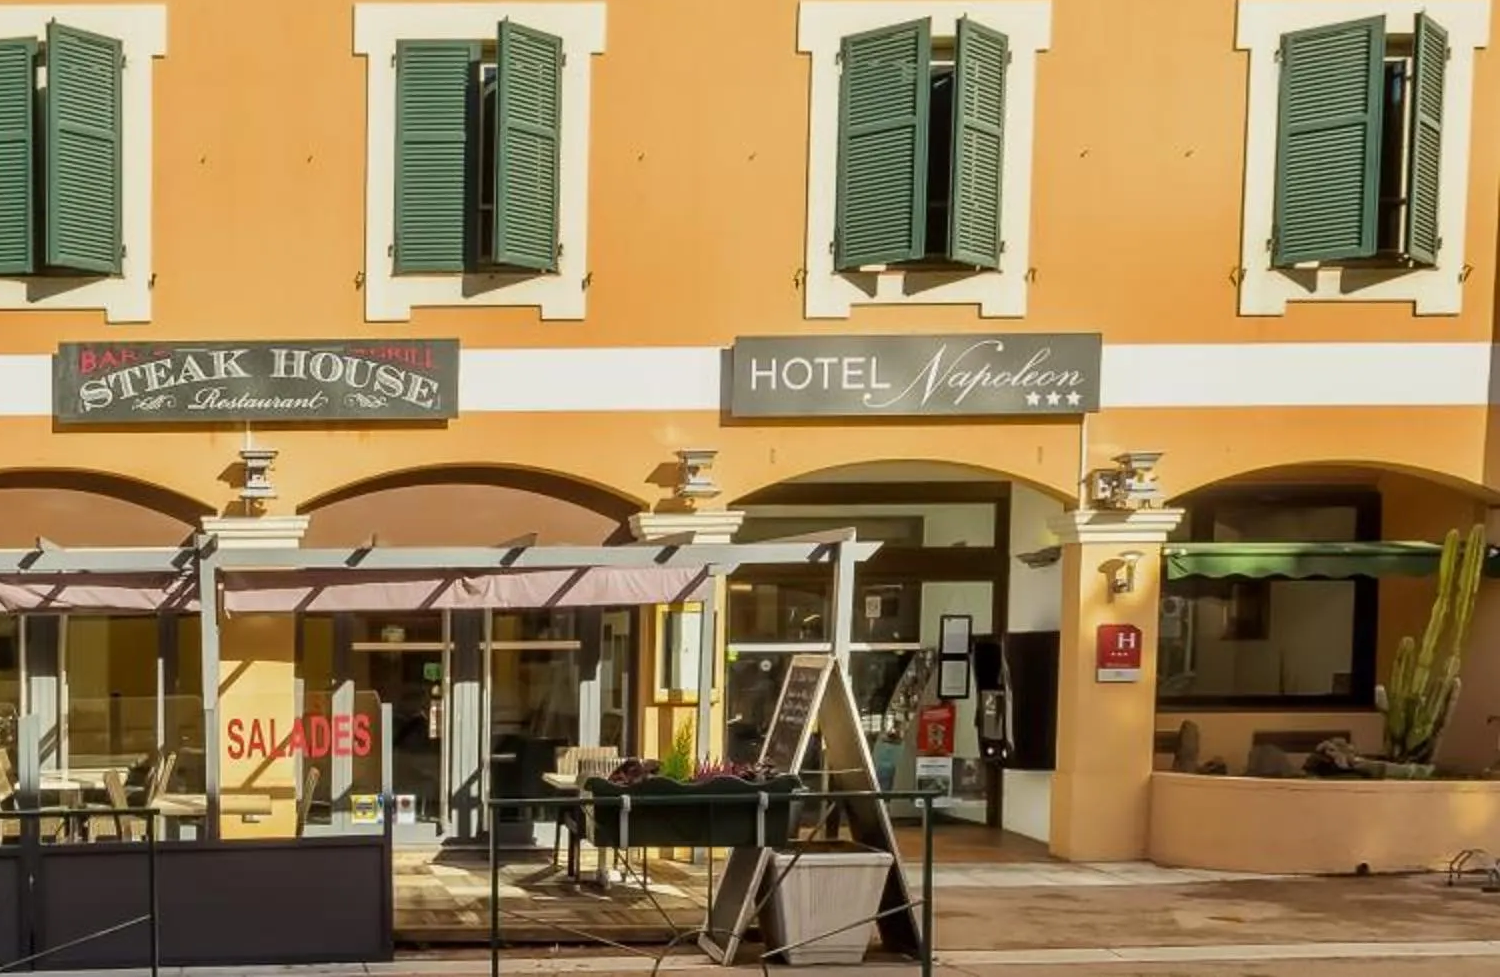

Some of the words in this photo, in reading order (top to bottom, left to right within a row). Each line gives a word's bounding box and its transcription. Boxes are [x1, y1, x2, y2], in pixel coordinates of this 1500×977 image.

[80, 348, 138, 374] BAR
[750, 357, 891, 391] HOTEL
[863, 340, 1088, 408] Napoleon
[80, 349, 253, 412] STEAK
[270, 348, 440, 409] HOUSE
[187, 386, 329, 412] Restaurant
[1118, 632, 1135, 649] H
[227, 713, 372, 760] SALADES
